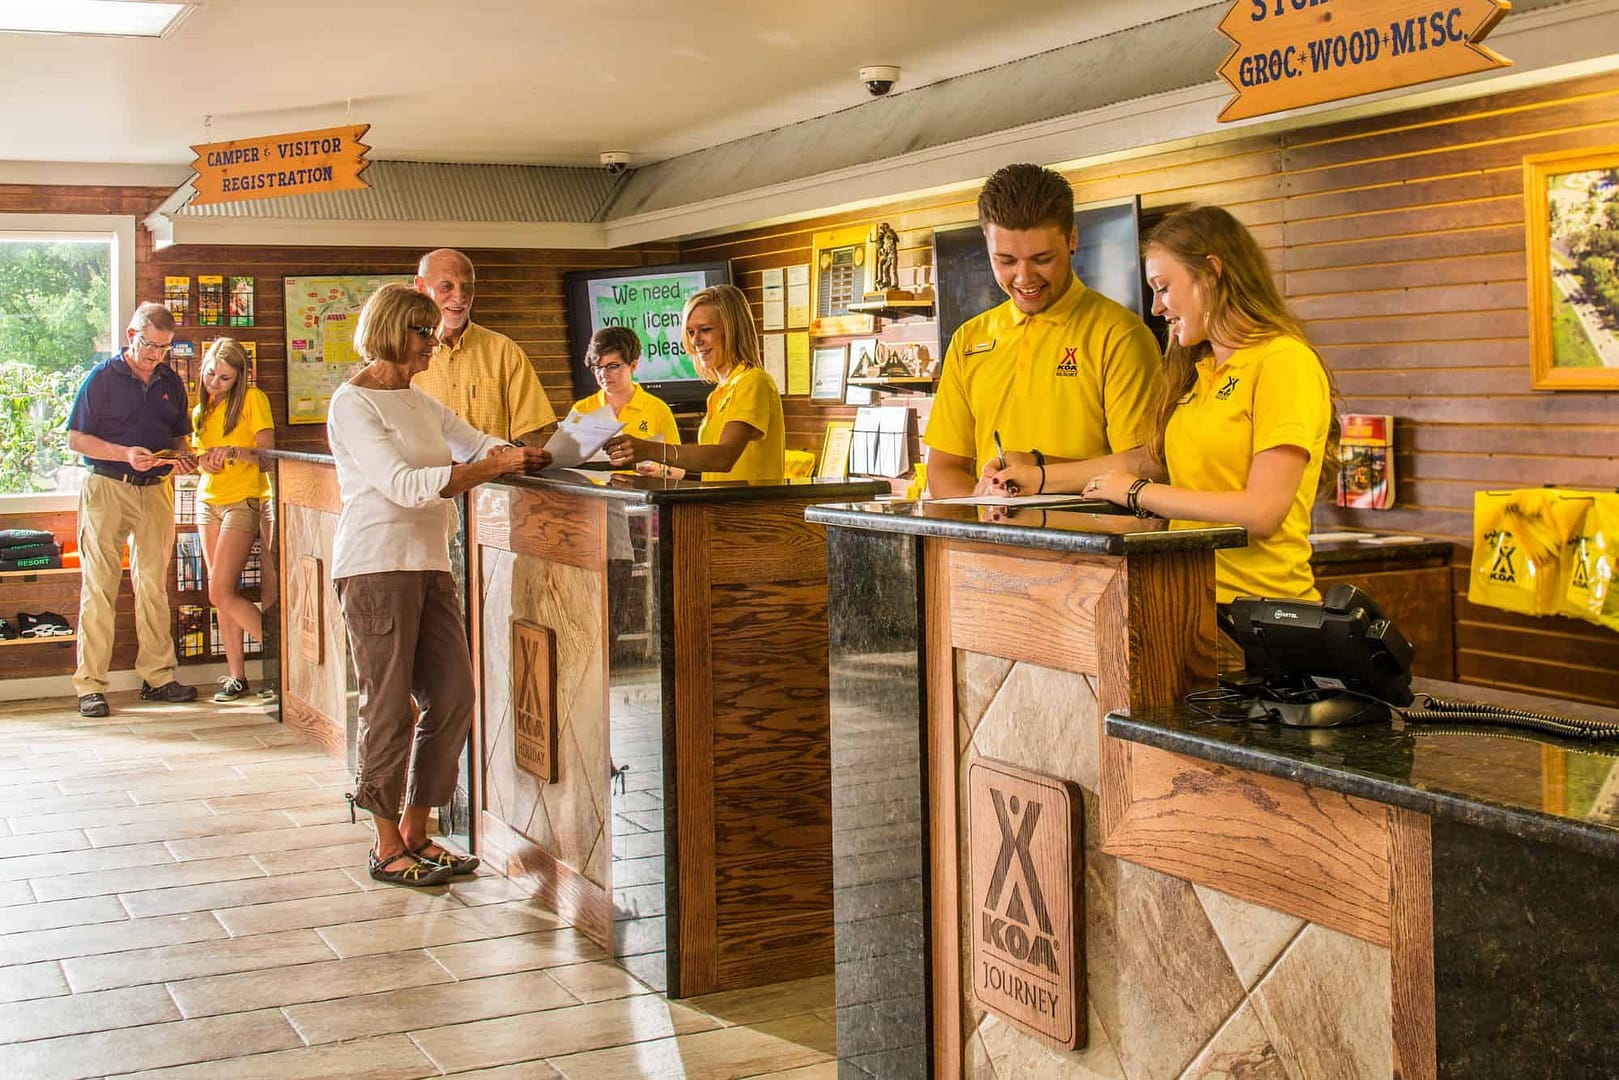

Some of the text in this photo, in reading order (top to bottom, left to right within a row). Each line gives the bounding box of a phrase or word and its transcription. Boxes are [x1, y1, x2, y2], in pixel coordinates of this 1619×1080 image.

[1307, 27, 1380, 73] WOOD
[207, 147, 259, 167] CAMPER
[277, 137, 341, 159] VISITOR
[222, 166, 333, 192] REGISTRATION
[611, 285, 637, 305] We
[643, 282, 681, 301] need
[643, 311, 683, 330] licen
[1490, 572, 1515, 583] KOA
[519, 741, 545, 767] HOLIDAY
[982, 960, 1059, 1018] JOURNEY
